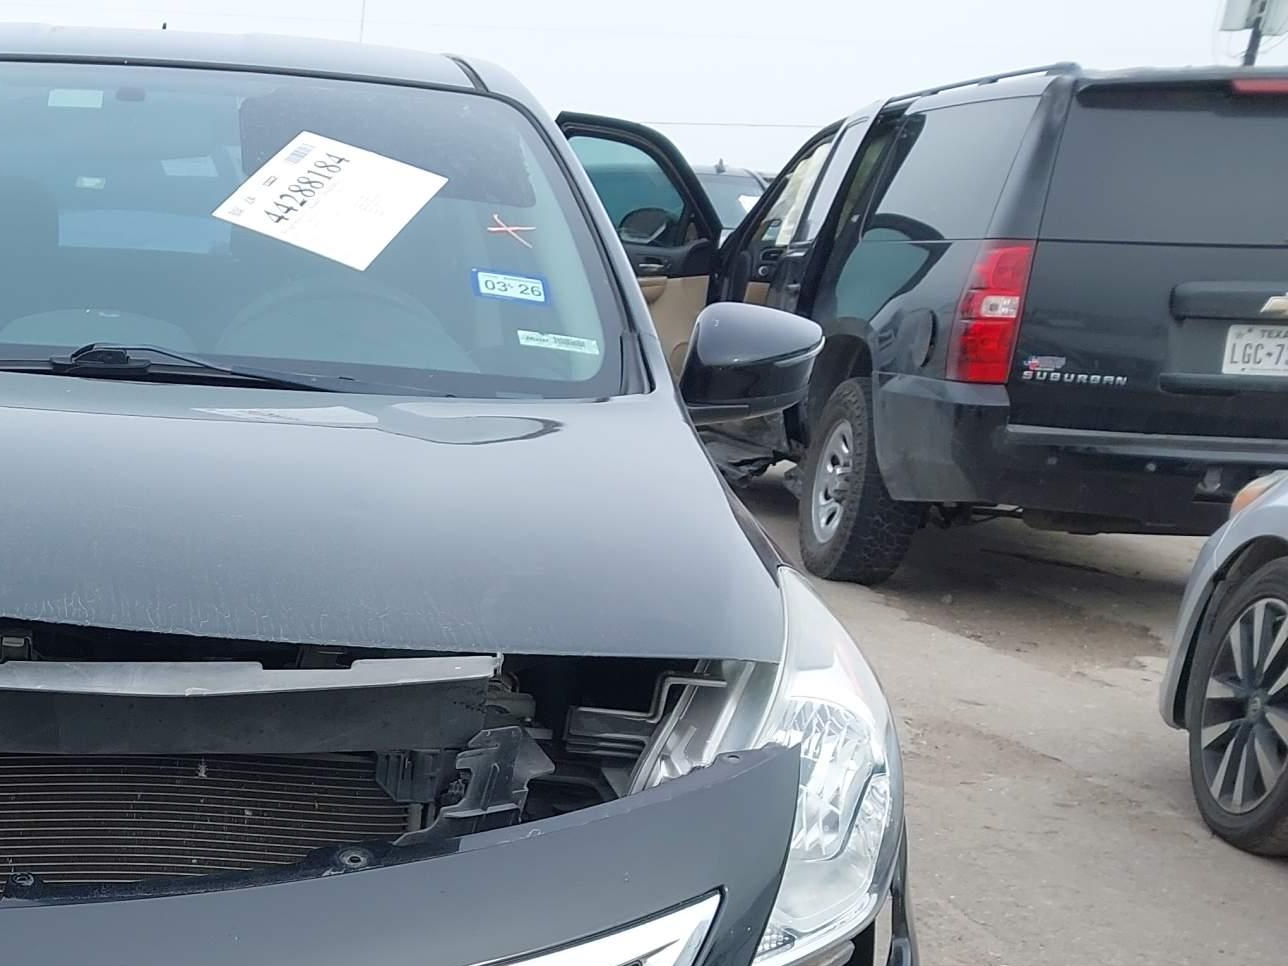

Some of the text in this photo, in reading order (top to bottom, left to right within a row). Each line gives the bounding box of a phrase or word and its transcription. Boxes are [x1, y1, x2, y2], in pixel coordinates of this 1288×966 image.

[264, 153, 350, 223] 44288184
[484, 279, 508, 292] 03
[518, 283, 542, 297] 26
[1230, 343, 1288, 365] LGC-7
[1022, 371, 1127, 385] SUBURBAN
